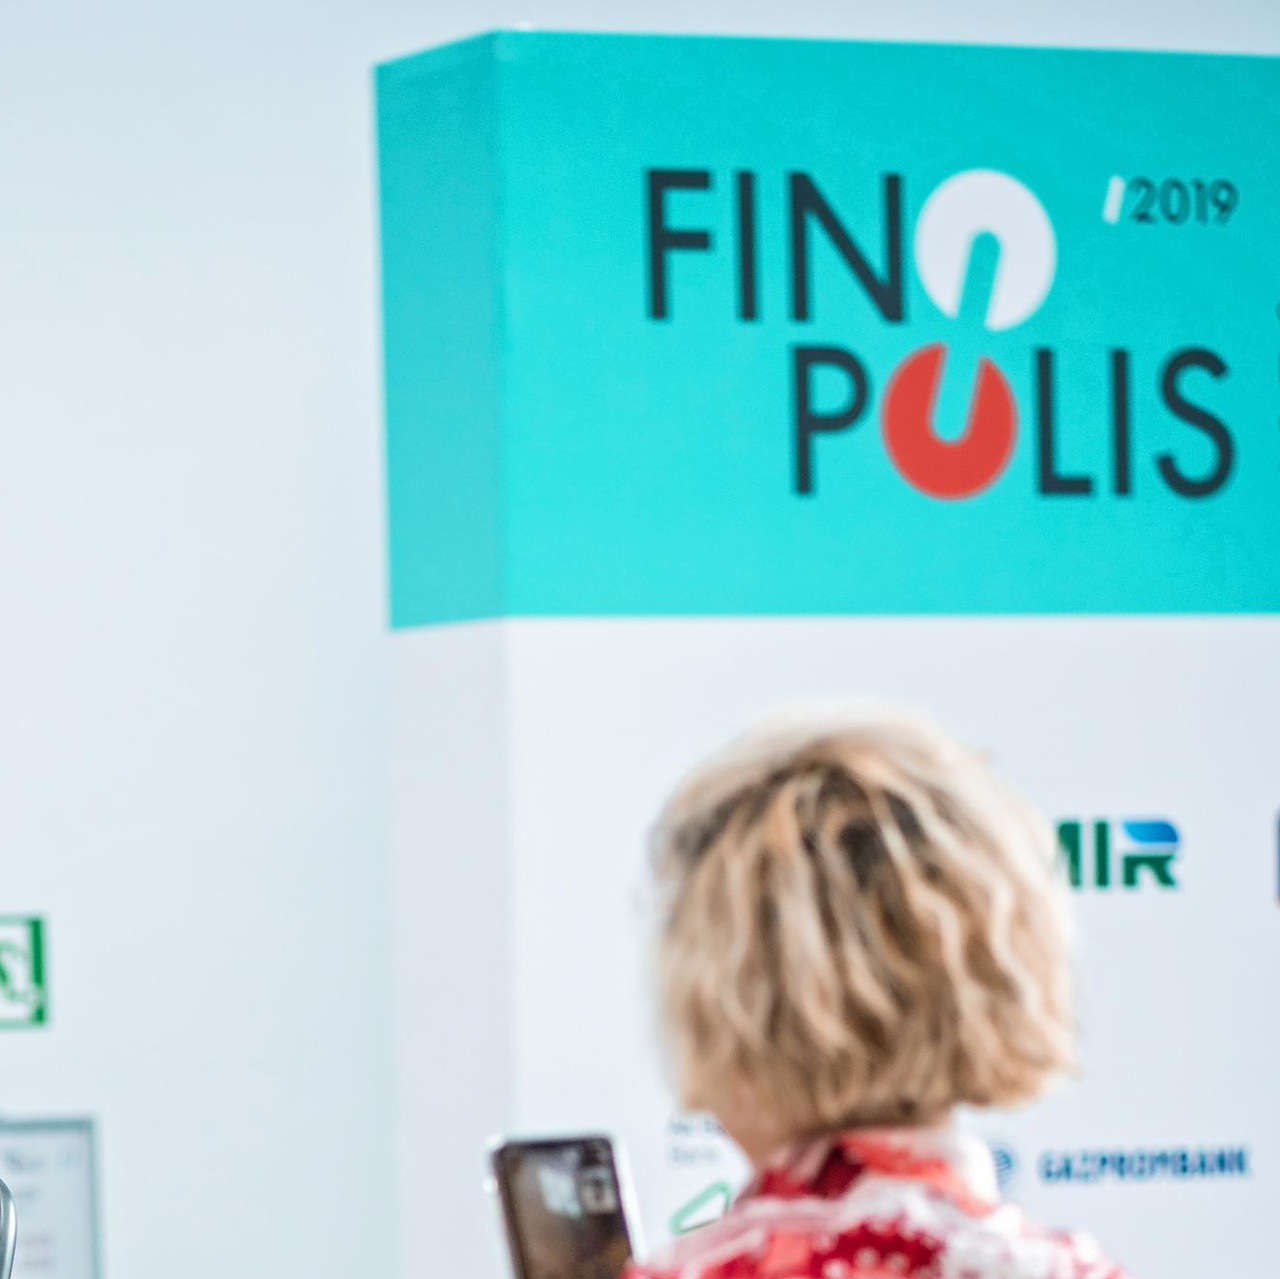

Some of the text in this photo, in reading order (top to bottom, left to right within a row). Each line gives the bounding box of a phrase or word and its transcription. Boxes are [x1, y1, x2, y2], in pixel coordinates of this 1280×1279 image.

[646, 168, 1056, 331] FINO
[790, 342, 1237, 501] POLIS
[1038, 1147, 1248, 1183] GAZPROMBANK
